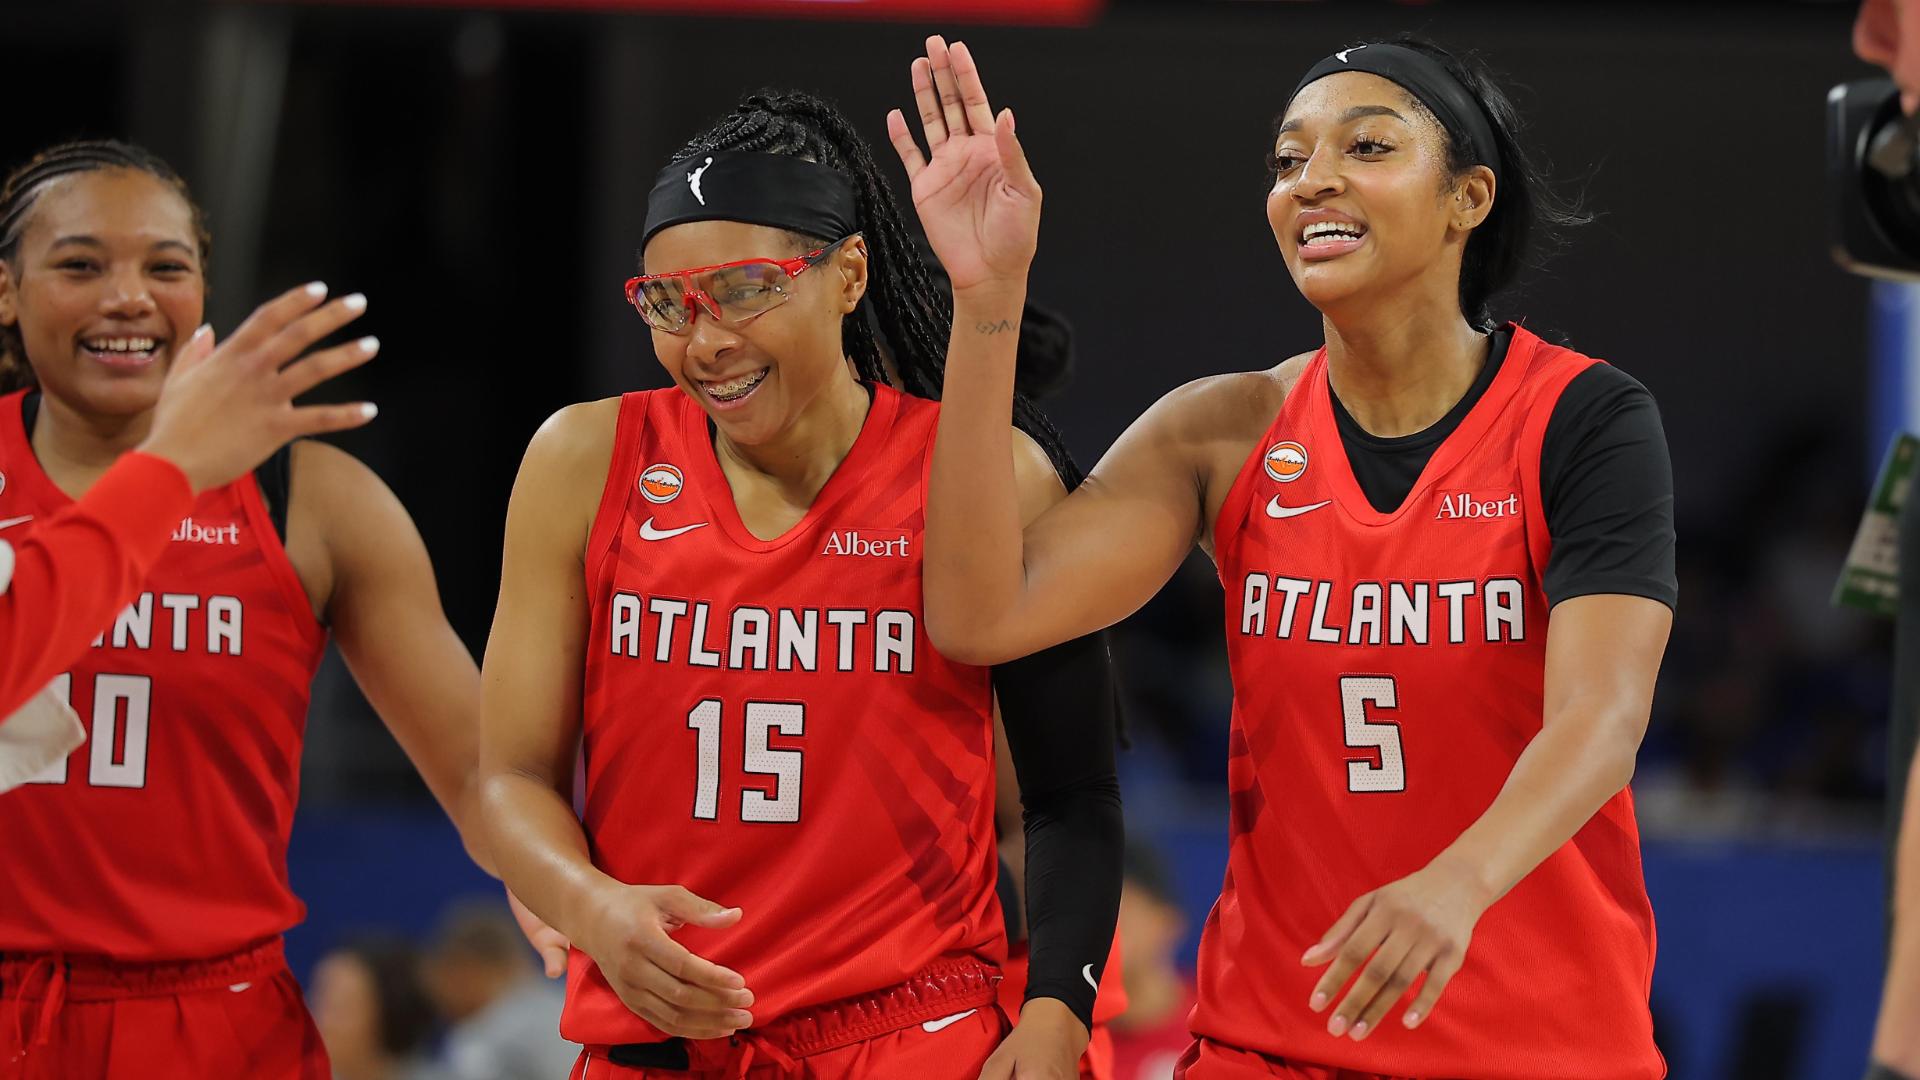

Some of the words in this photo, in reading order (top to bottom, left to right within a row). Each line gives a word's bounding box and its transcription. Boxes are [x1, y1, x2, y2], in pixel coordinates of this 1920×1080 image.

[821, 530, 909, 557] Albert
[1435, 492, 1518, 520] Albert
[610, 591, 916, 674] ATLANTA
[1241, 572, 1526, 645] ATLANTA
[686, 697, 806, 823] 15
[1339, 675, 1406, 793] 5
